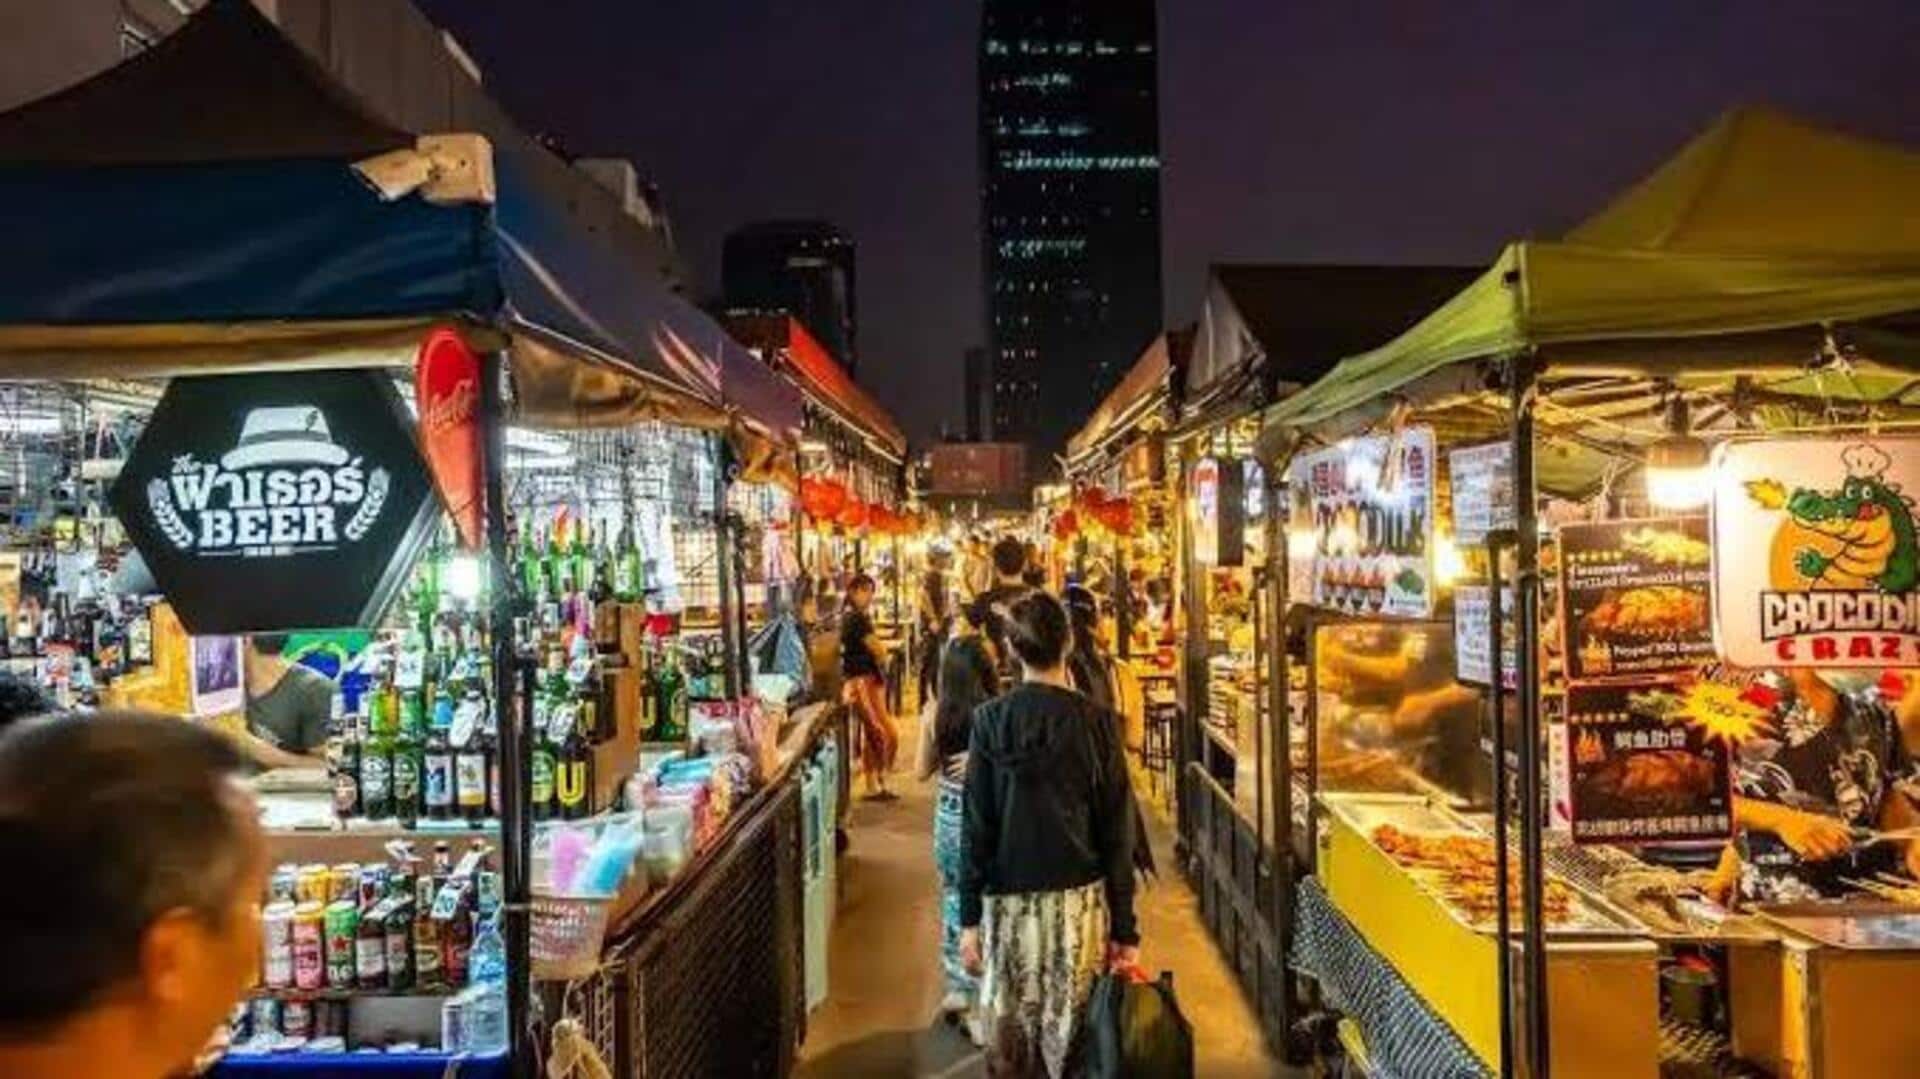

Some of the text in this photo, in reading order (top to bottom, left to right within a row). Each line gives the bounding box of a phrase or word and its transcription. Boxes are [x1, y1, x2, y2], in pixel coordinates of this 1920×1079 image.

[171, 456, 364, 511] ฟาเธอร์
[198, 505, 338, 548] BEER
[1761, 589, 1920, 641] CROCODI
[557, 760, 586, 807] U
